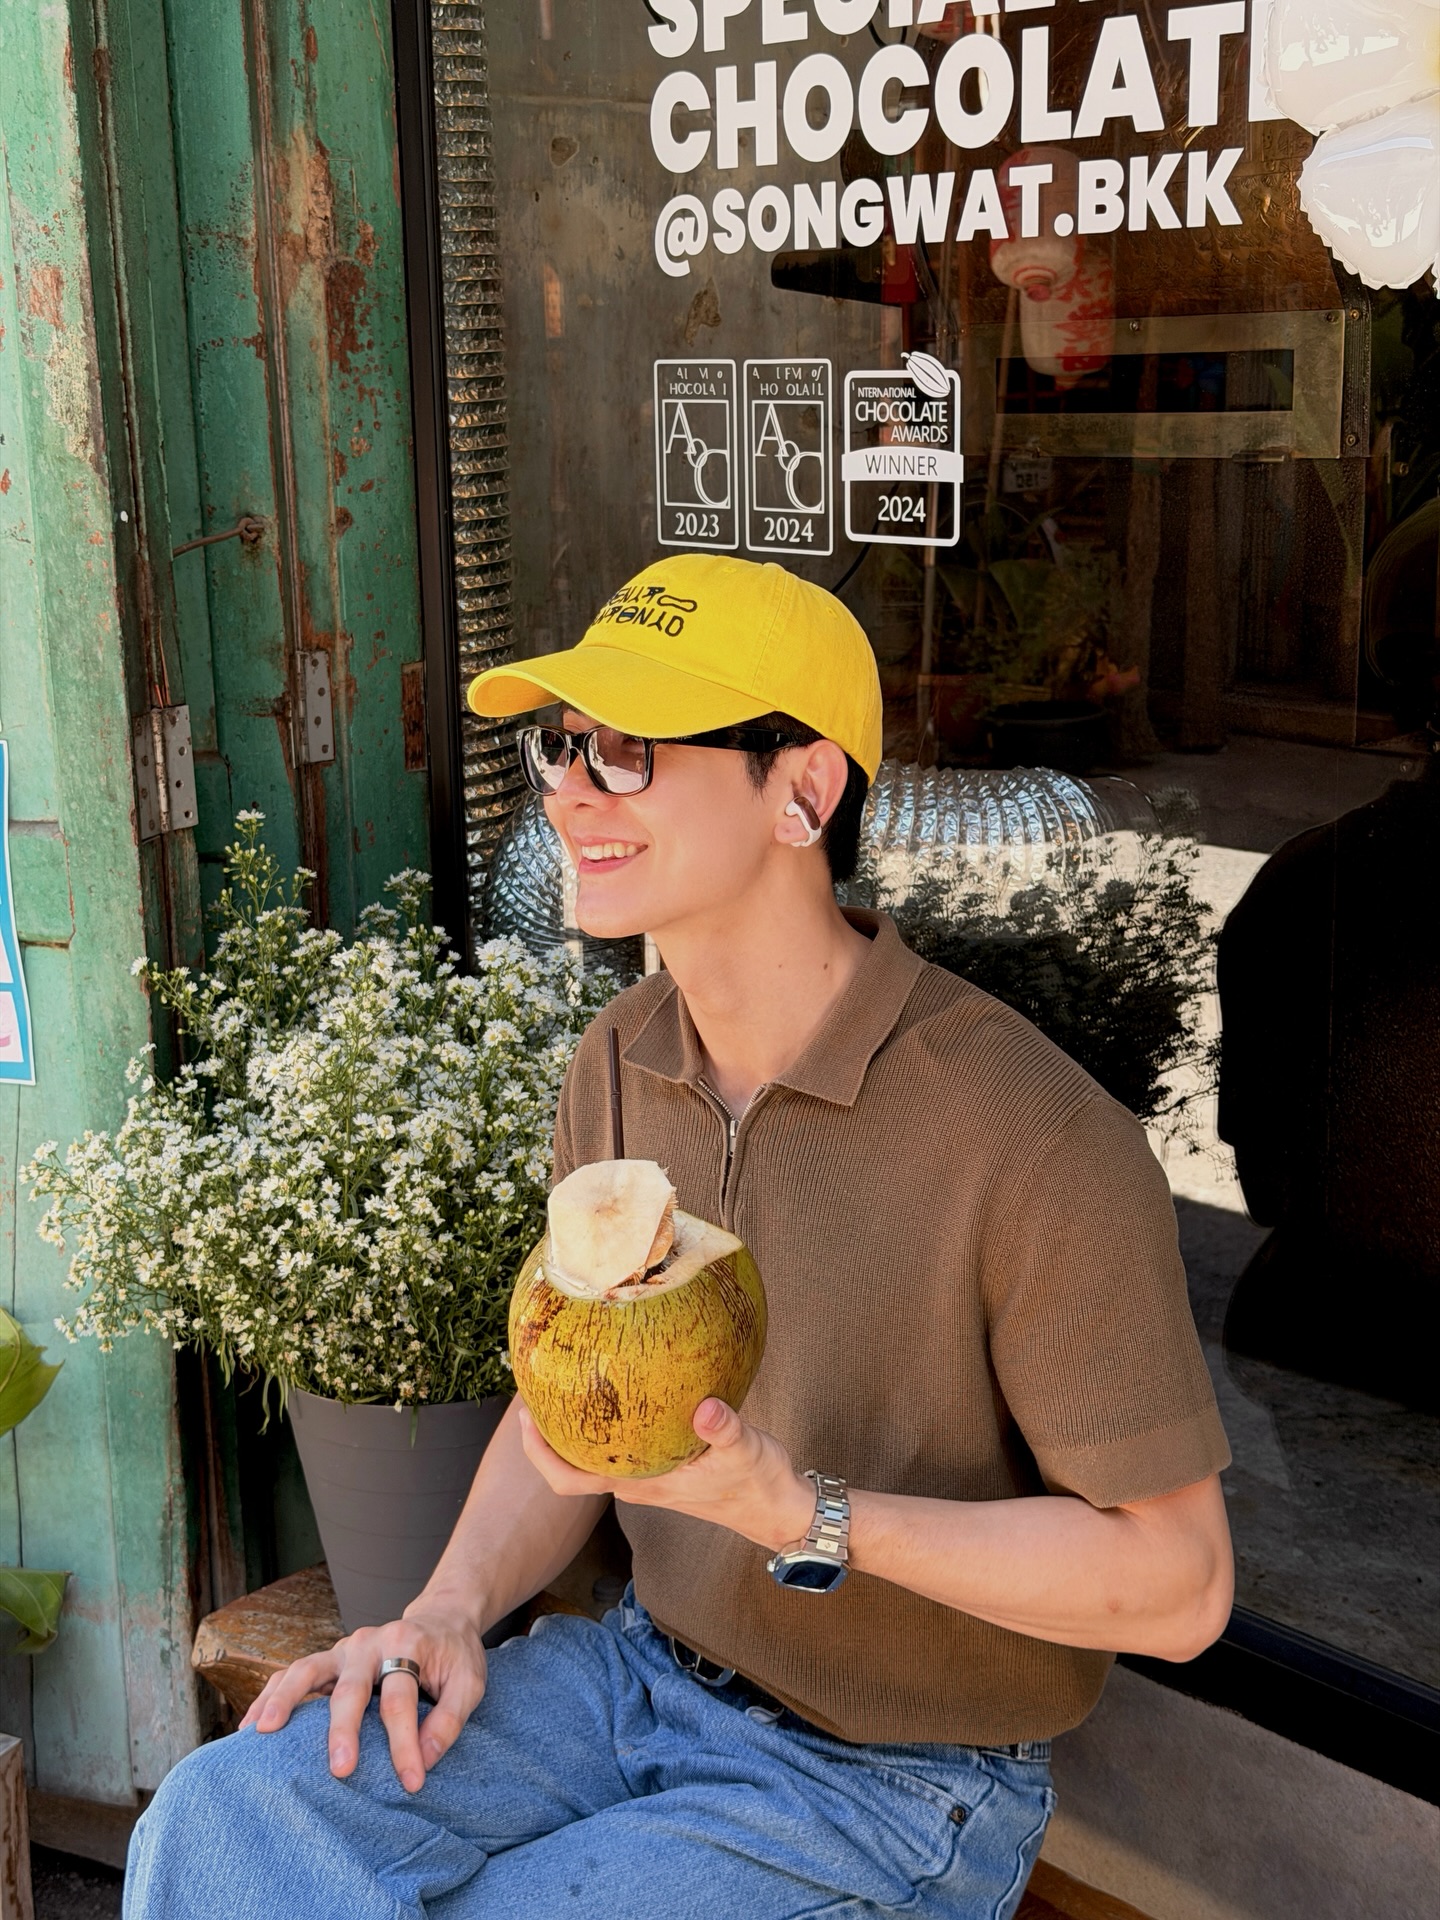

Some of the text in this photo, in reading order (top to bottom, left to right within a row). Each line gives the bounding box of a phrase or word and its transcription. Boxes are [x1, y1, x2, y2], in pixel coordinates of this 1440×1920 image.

[653, 148, 1244, 278] @SONGWAT.BKK
[855, 401, 948, 423] CHOCOLATE
[891, 425, 948, 443] AWARDS
[865, 454, 938, 476] WINNER
[878, 495, 926, 523] 2024
[674, 512, 721, 538] 2023
[763, 517, 815, 543] 2024
